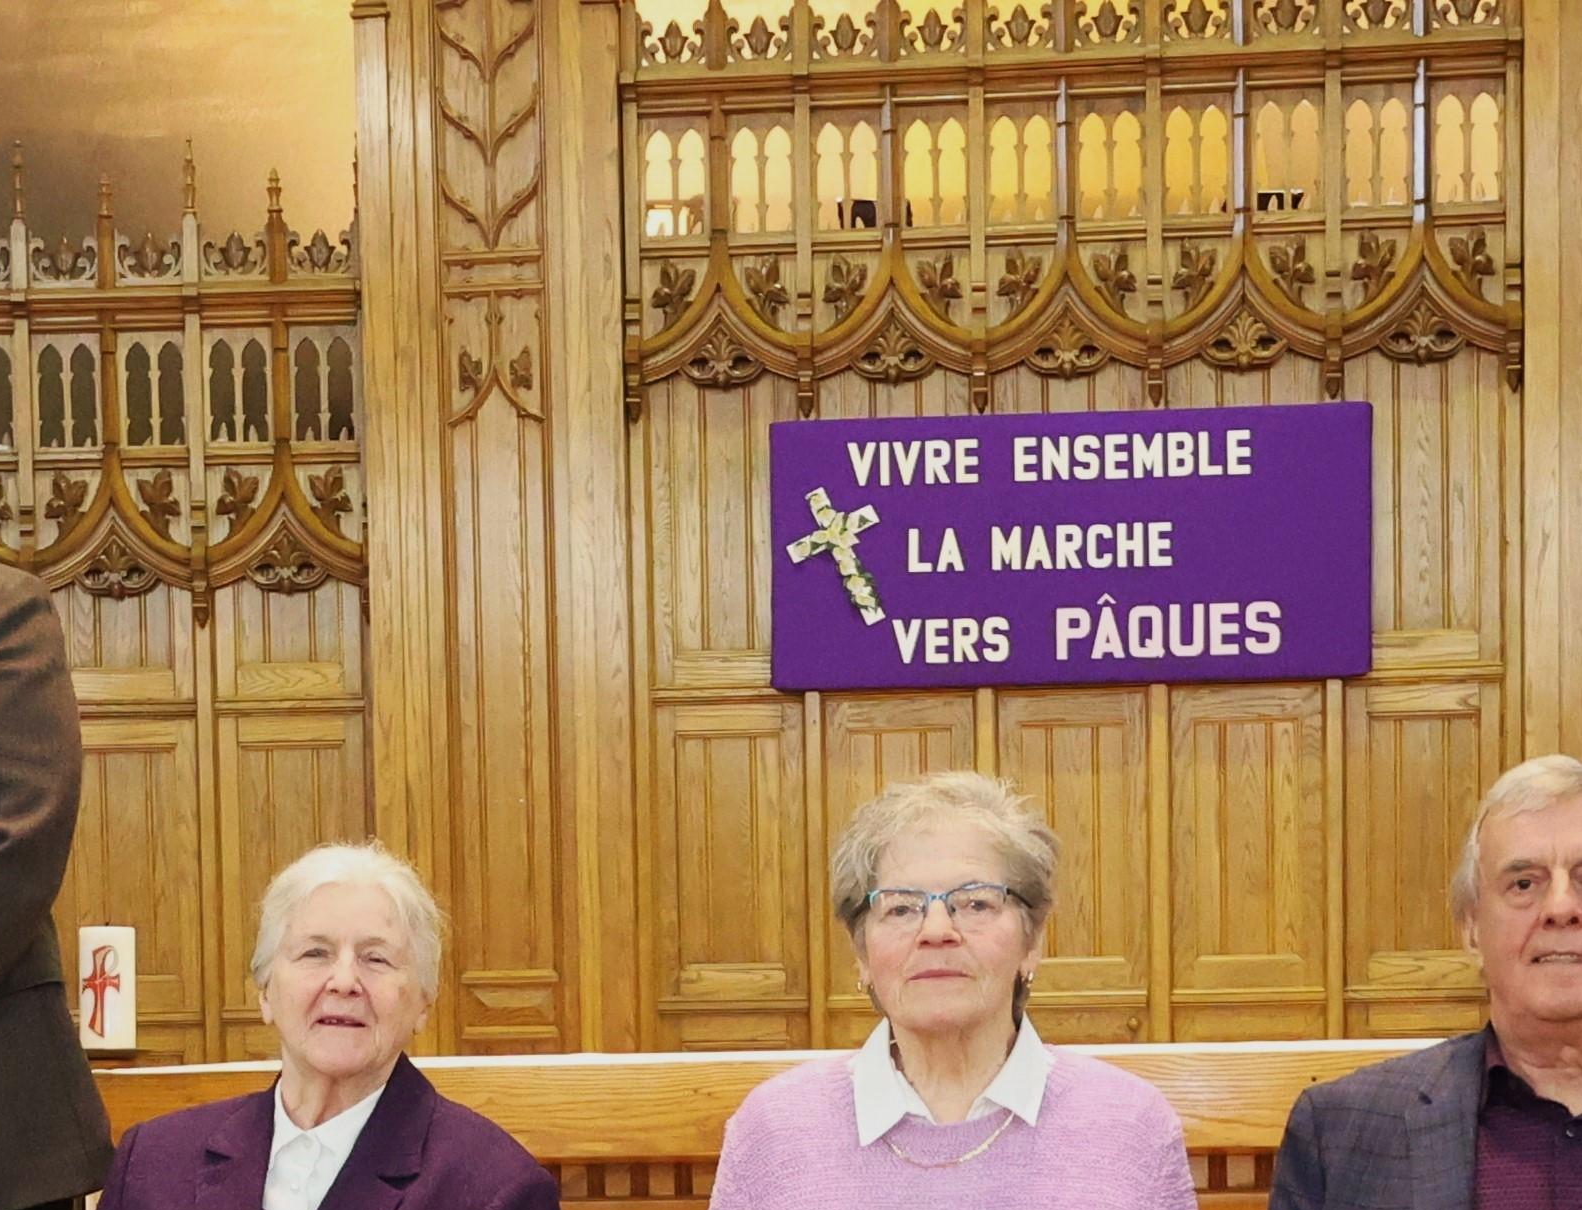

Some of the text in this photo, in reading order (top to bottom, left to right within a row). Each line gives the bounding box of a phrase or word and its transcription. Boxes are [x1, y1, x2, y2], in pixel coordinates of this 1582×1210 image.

[848, 429, 1252, 487] VIVRE ENSEMBLE
[907, 521, 1174, 573] LA MARCHE
[891, 592, 1281, 664] VERS PÂQUES
